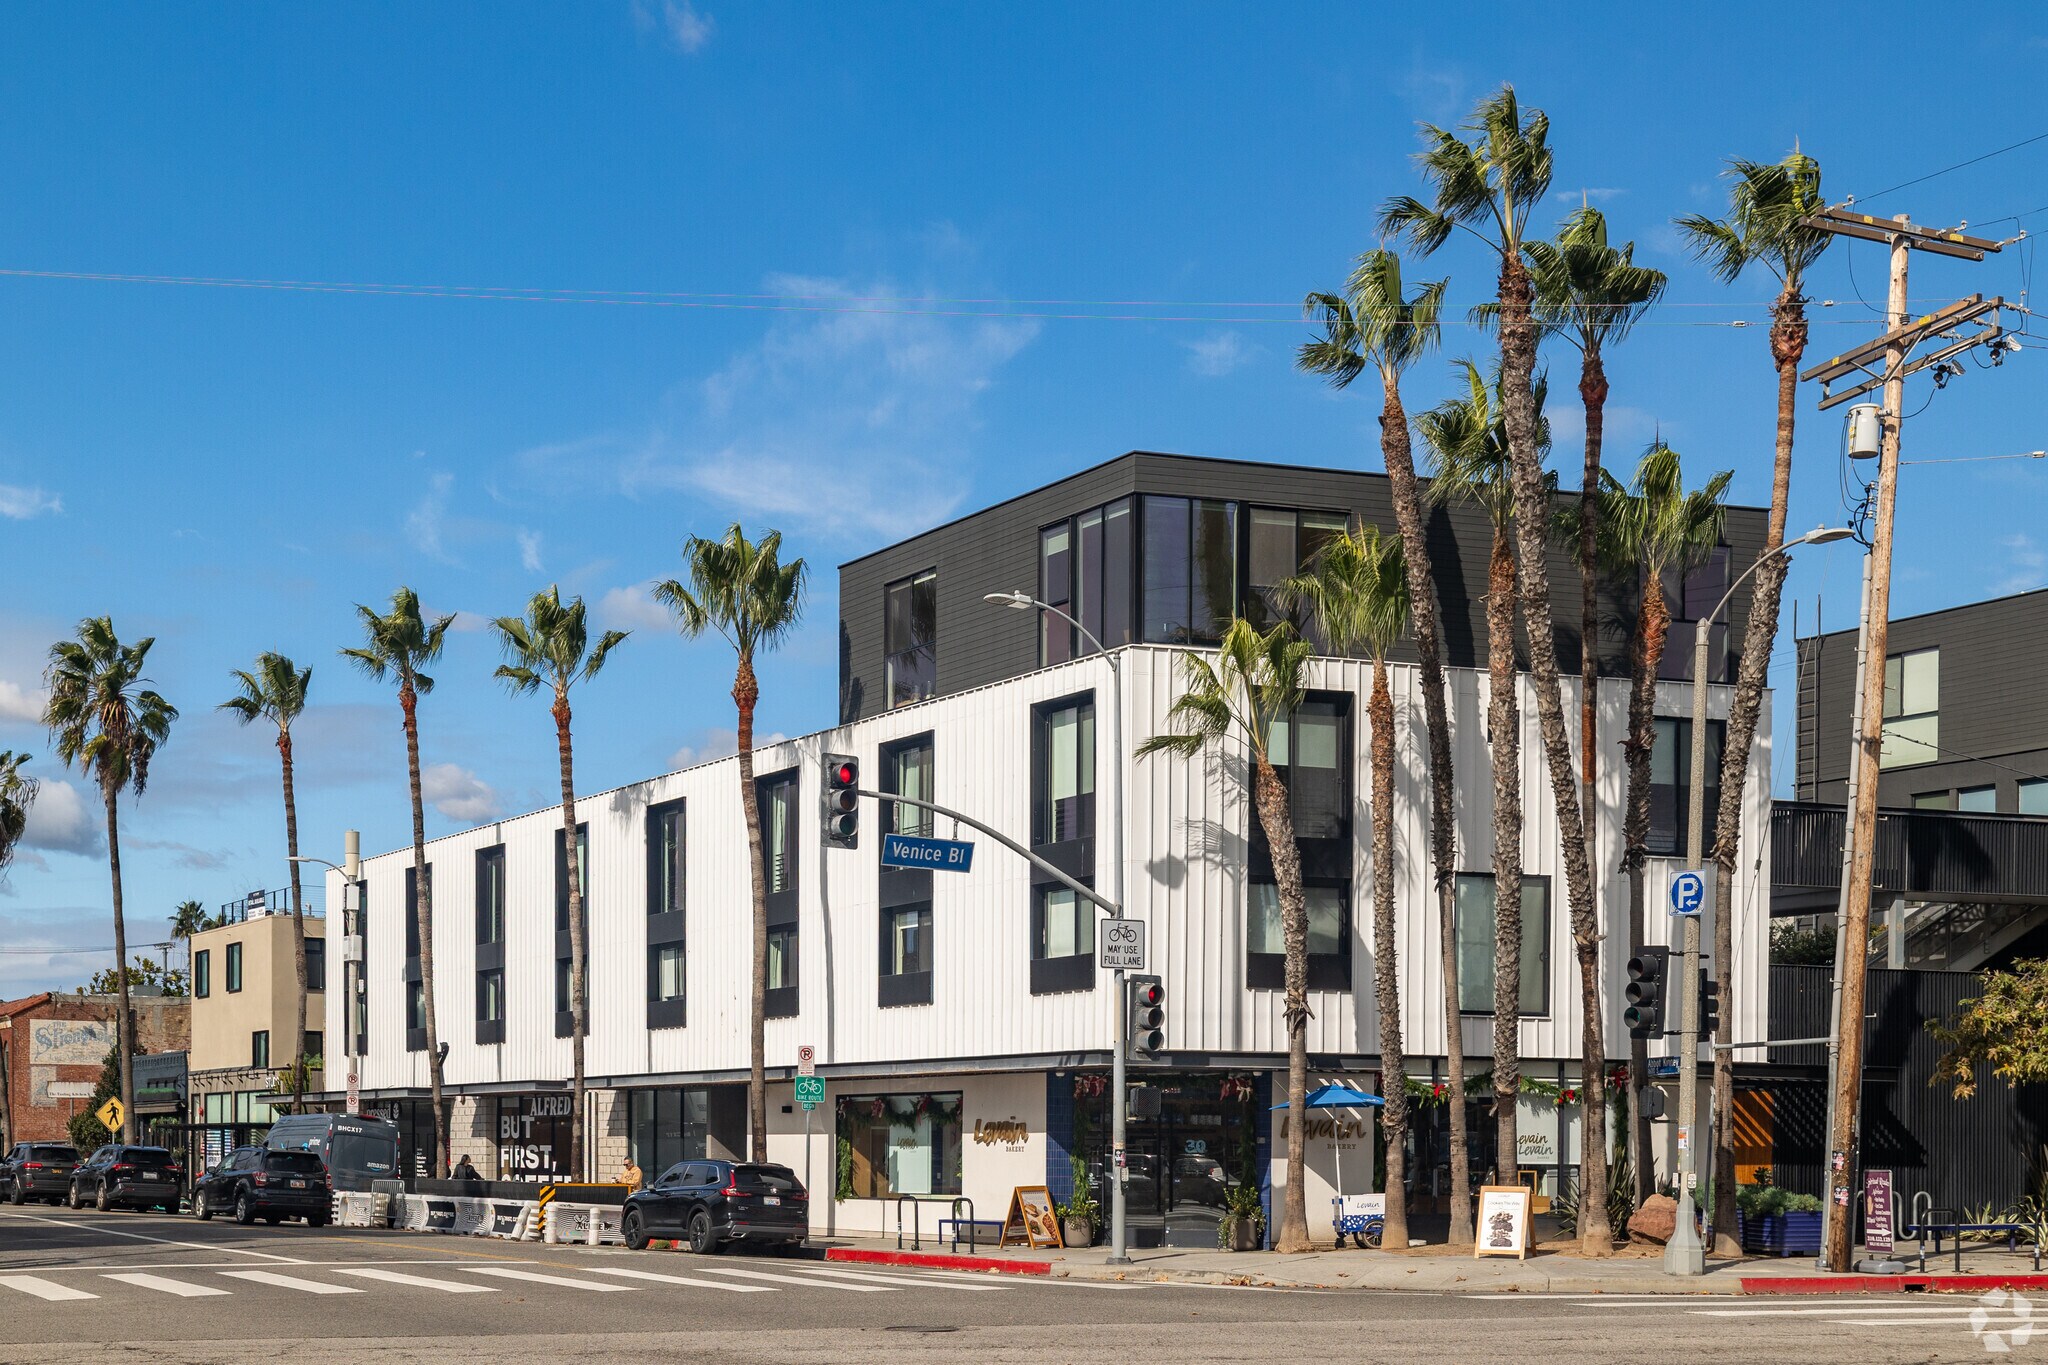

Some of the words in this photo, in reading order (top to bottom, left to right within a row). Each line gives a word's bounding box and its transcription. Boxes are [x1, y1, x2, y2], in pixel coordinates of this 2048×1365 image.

[893, 842, 942, 862] Venice
[948, 848, 965, 864] Bl
[1107, 945, 1121, 954] MAY
[1124, 946, 1138, 955] USE
[1104, 956, 1121, 965] FULL
[1123, 957, 1141, 966] LANE
[530, 1096, 571, 1116] ALFRED
[337, 1125, 363, 1133] BHCX17
[501, 1115, 535, 1139] BUT
[1516, 1132, 1549, 1145] evain
[1518, 1144, 1554, 1156] Levain
[500, 1144, 557, 1172] FIRST,
[366, 1161, 390, 1170] amazon
